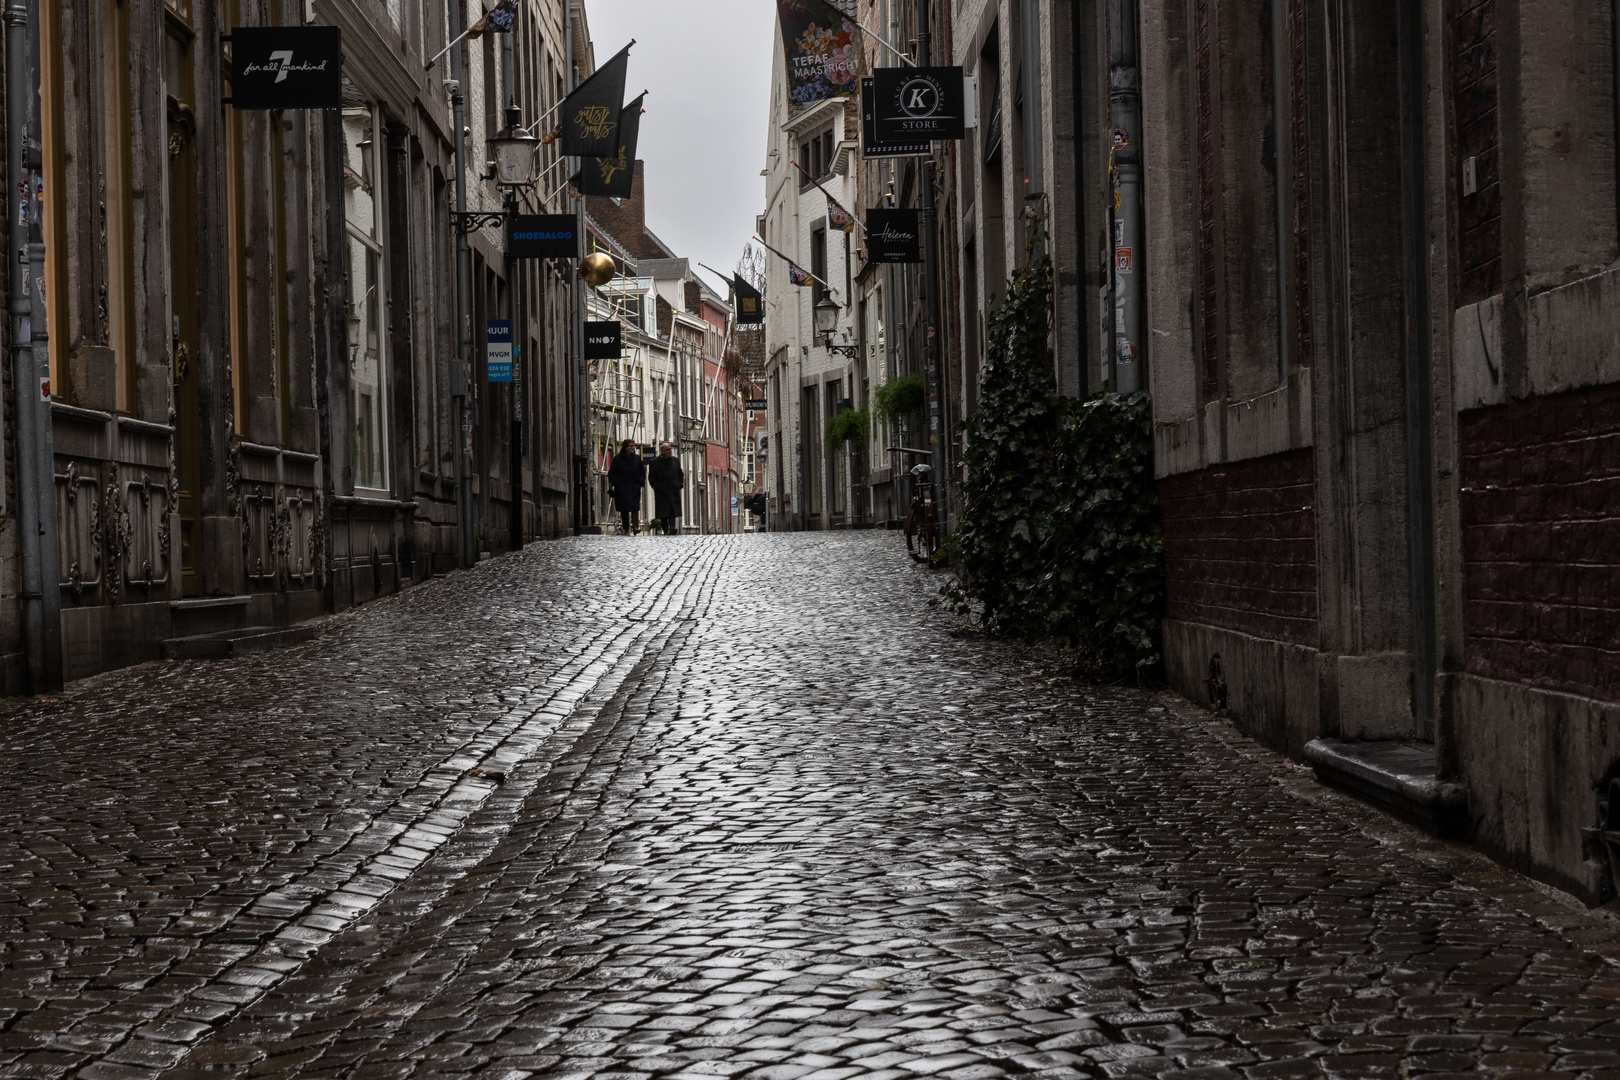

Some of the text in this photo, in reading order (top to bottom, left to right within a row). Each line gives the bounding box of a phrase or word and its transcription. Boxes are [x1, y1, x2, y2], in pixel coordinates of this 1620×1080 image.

[243, 59, 327, 76] for all mankind
[269, 50, 293, 84] 7
[792, 53, 829, 67] TEFAF
[793, 59, 859, 78] MAASTRICHT
[906, 88, 931, 108] K
[902, 120, 938, 129] STORE
[513, 231, 573, 240] SHOEBALOO
